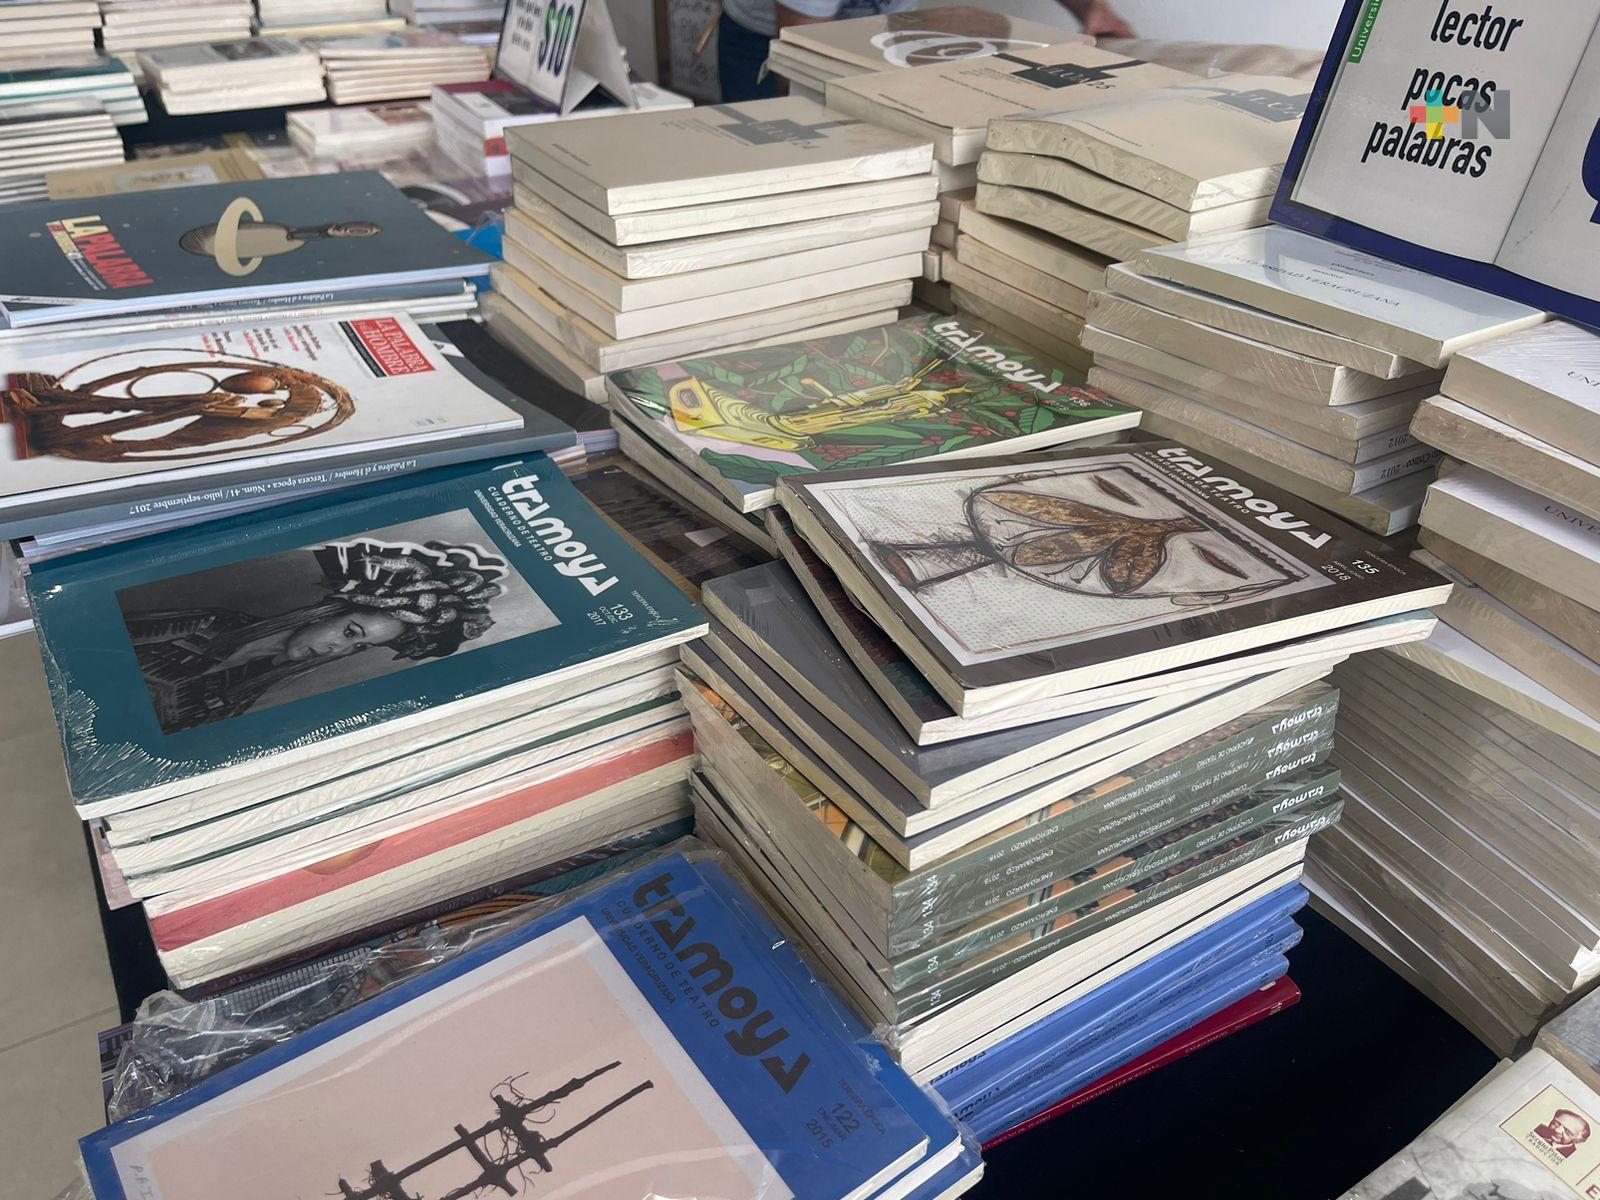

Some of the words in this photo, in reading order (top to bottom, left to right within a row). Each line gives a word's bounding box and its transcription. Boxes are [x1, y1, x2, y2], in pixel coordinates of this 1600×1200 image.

[1352, 0, 1380, 57] Universi
[1430, 0, 1524, 52] lector
[1401, 68, 1497, 113] pocas
[1361, 117, 1492, 178] palabras
[377, 461, 406, 474] Palabra
[406, 459, 417, 468] La
[1381, 464, 1401, 480] 2012
[298, 474, 328, 485] Tercera
[334, 468, 364, 479] Hombre
[241, 484, 266, 494] Núm.
[273, 478, 298, 489] época
[153, 489, 224, 509] julio-septiembre
[1194, 480, 1211, 491] DE
[1210, 488, 1250, 514] TEATRO
[129, 503, 152, 515] 2017
[474, 489, 499, 518] UNIVERSIDAD
[494, 515, 523, 549] VERACRUZANA
[487, 486, 523, 526] CUADERNO
[517, 525, 530, 536] DE
[525, 532, 553, 561] TEATRO
[1321, 564, 1351, 581] 2018
[1352, 560, 1380, 574] 135
[587, 611, 607, 626] 2017
[610, 603, 634, 621] 133
[617, 900, 667, 961] CUADERNO
[664, 961, 681, 980] DE
[679, 979, 720, 1029] TEATRO
[635, 951, 676, 1005] VERACRUZANA
[831, 1103, 860, 1133] 122
[805, 1118, 833, 1149] 2015
